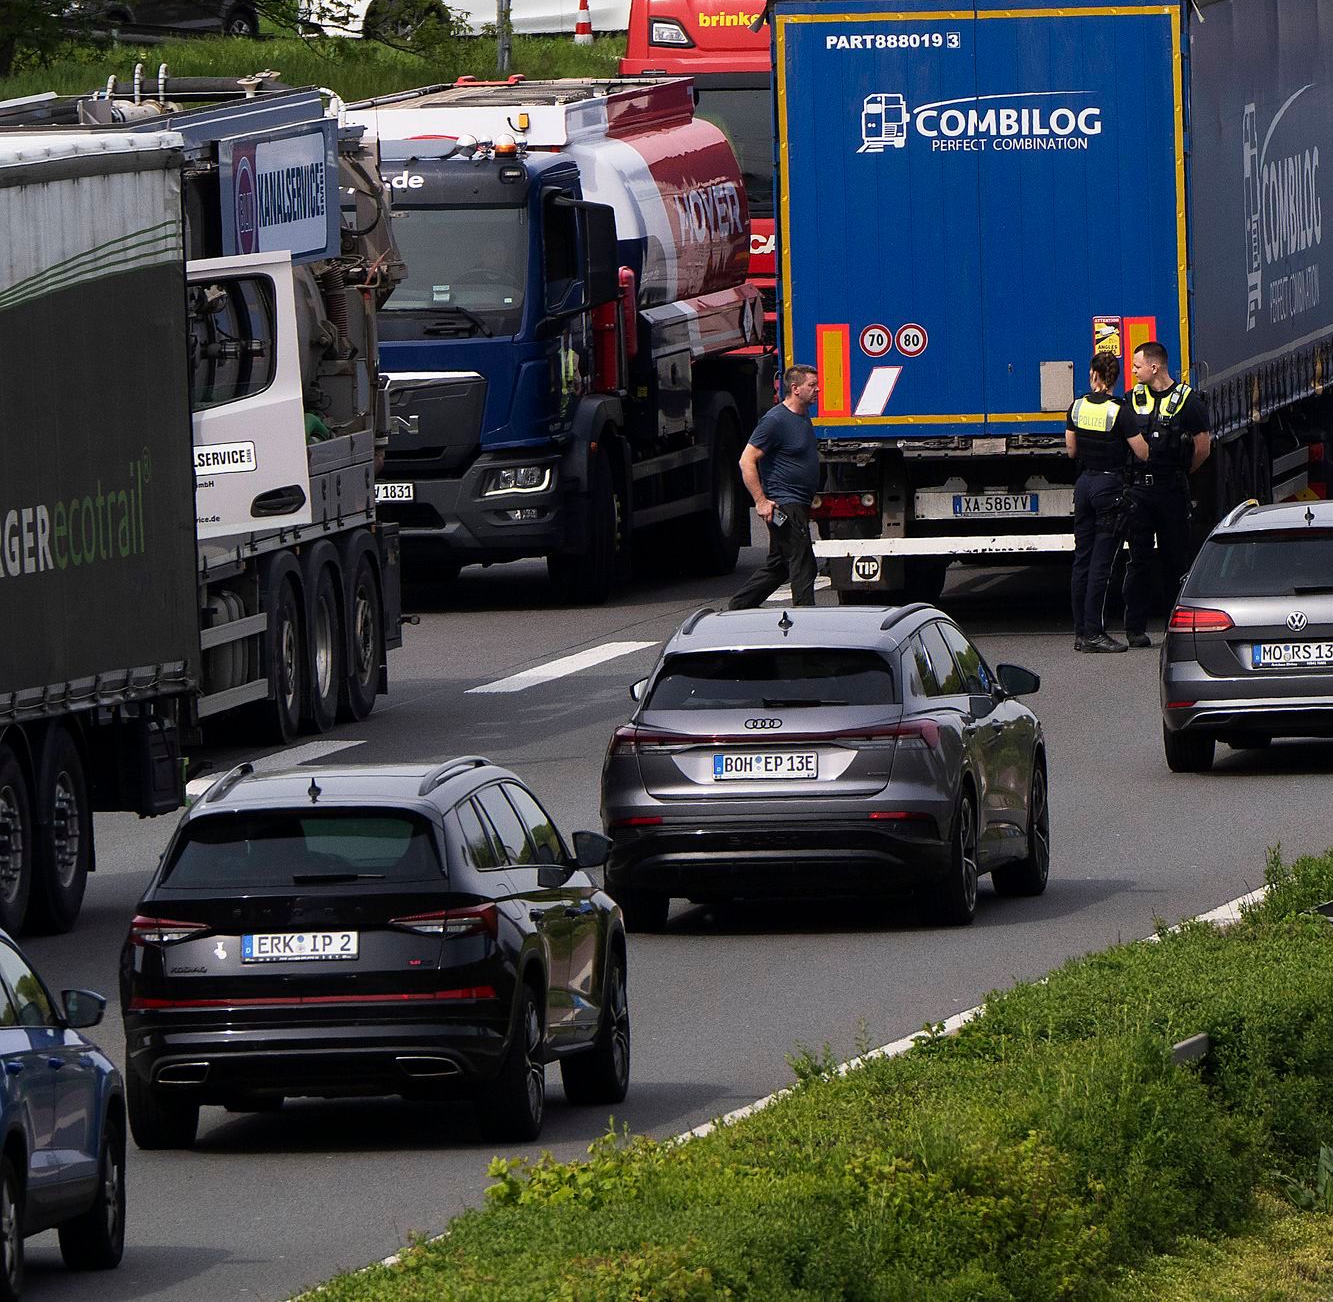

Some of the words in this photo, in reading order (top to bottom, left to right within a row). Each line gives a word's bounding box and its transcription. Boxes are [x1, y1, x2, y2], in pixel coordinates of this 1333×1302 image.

[826, 33, 943, 49] PART888019
[948, 34, 959, 48] 3
[915, 107, 1101, 138] COMBILOG
[932, 138, 987, 152] PERFECT
[993, 137, 1088, 151] COMBINATION
[257, 164, 322, 228] KANALSERVICE
[1262, 145, 1322, 265] COMBILOG
[868, 333, 884, 346] 70
[903, 333, 920, 346] 80
[1079, 415, 1105, 429] POLIZEI
[382, 485, 412, 498] 1831
[857, 562, 878, 575] TIP
[1263, 645, 1282, 661] MO
[1292, 645, 1311, 660] RS
[725, 756, 753, 773] BOH
[764, 756, 783, 772] EP
[786, 755, 814, 771] 13E
[257, 936, 294, 954] ERK
[310, 935, 332, 952] IP
[341, 934, 351, 951] 2
